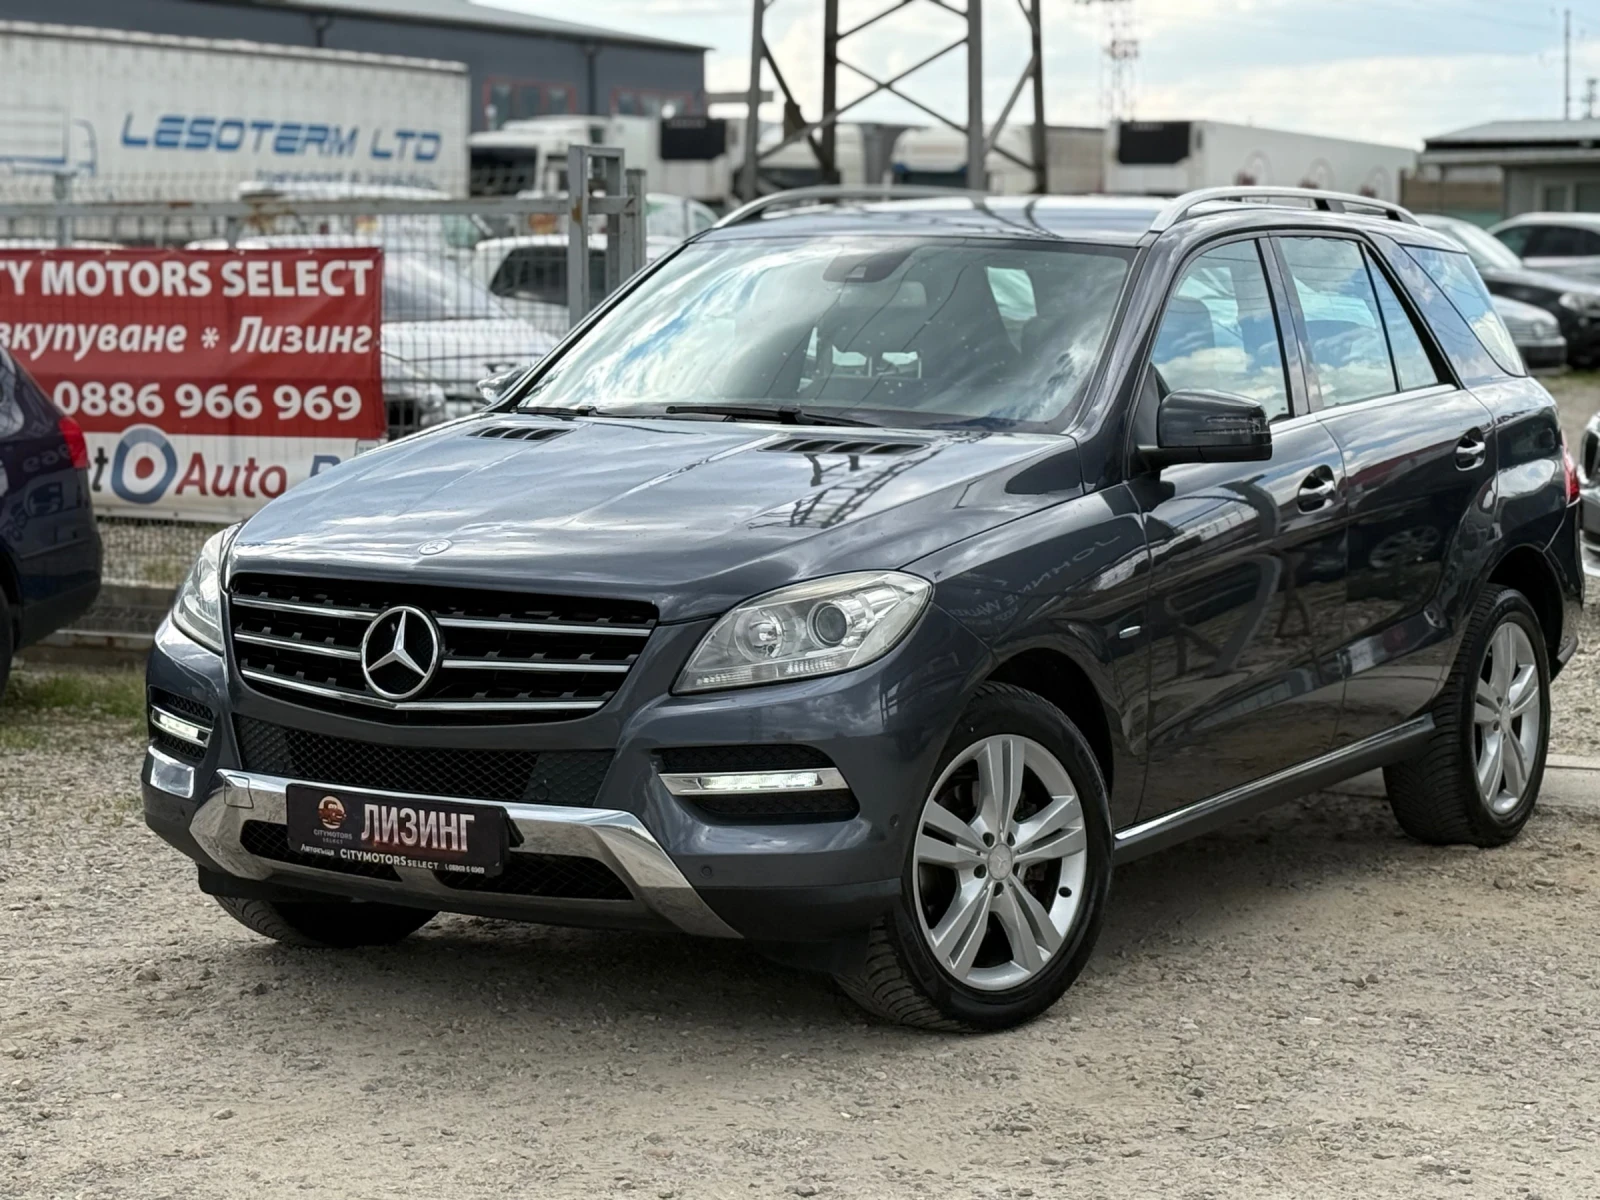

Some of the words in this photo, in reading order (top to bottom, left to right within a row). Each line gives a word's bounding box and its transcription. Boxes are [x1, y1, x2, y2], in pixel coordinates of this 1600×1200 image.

[121, 112, 359, 158] LESOTERM
[370, 130, 441, 162] LTD
[41, 259, 212, 297] MOTORS
[221, 259, 373, 297] SELECT
[230, 316, 373, 354] Лизинг
[53, 381, 165, 418] 0886
[174, 383, 262, 419] 966
[273, 385, 362, 421] 969
[175, 452, 287, 499] Auto
[313, 828, 353, 840] CITYMOTORS
[361, 803, 475, 852] ЛИЗИНГ
